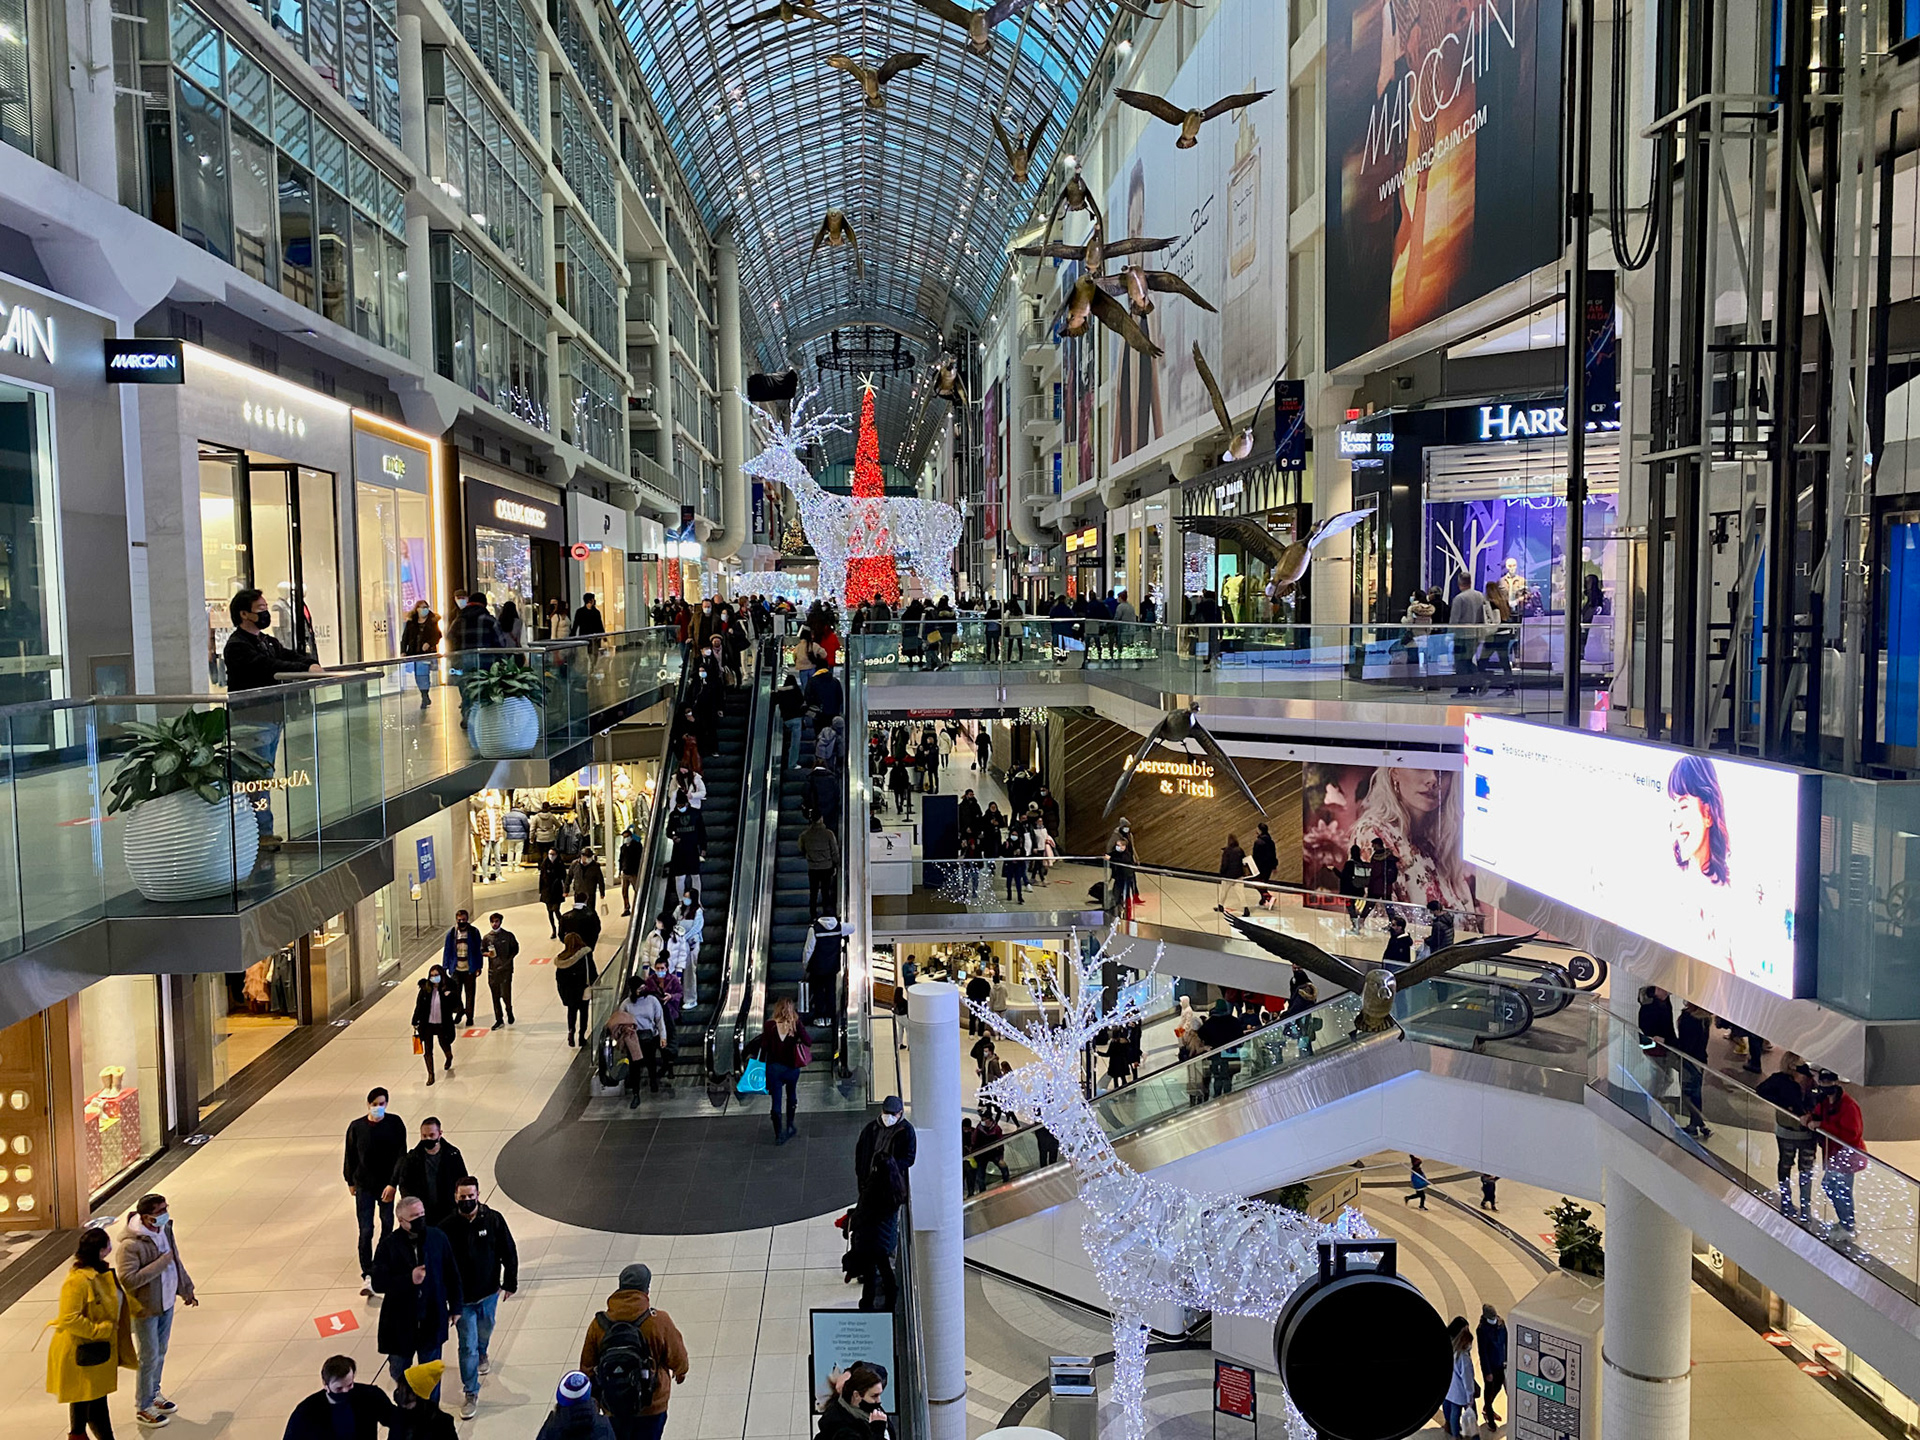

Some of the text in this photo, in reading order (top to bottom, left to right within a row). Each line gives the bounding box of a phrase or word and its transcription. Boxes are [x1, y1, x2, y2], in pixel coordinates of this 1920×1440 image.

[1378, 104, 1488, 201] WWW.MARC-CAIN.COM
[0, 302, 54, 365] AIN
[1479, 404, 1568, 440] HARR
[1340, 431, 1373, 442] HARRY
[1340, 442, 1371, 452] ROSEN
[315, 625, 331, 638] SALE
[374, 620, 388, 633] SALE
[1160, 779, 1215, 798] & Fitch
[1577, 966, 1586, 978] 2
[1537, 988, 1546, 1000] 2
[1504, 1001, 1518, 1009] evel
[1505, 1008, 1513, 1021] 2
[1527, 1378, 1554, 1396] dori
